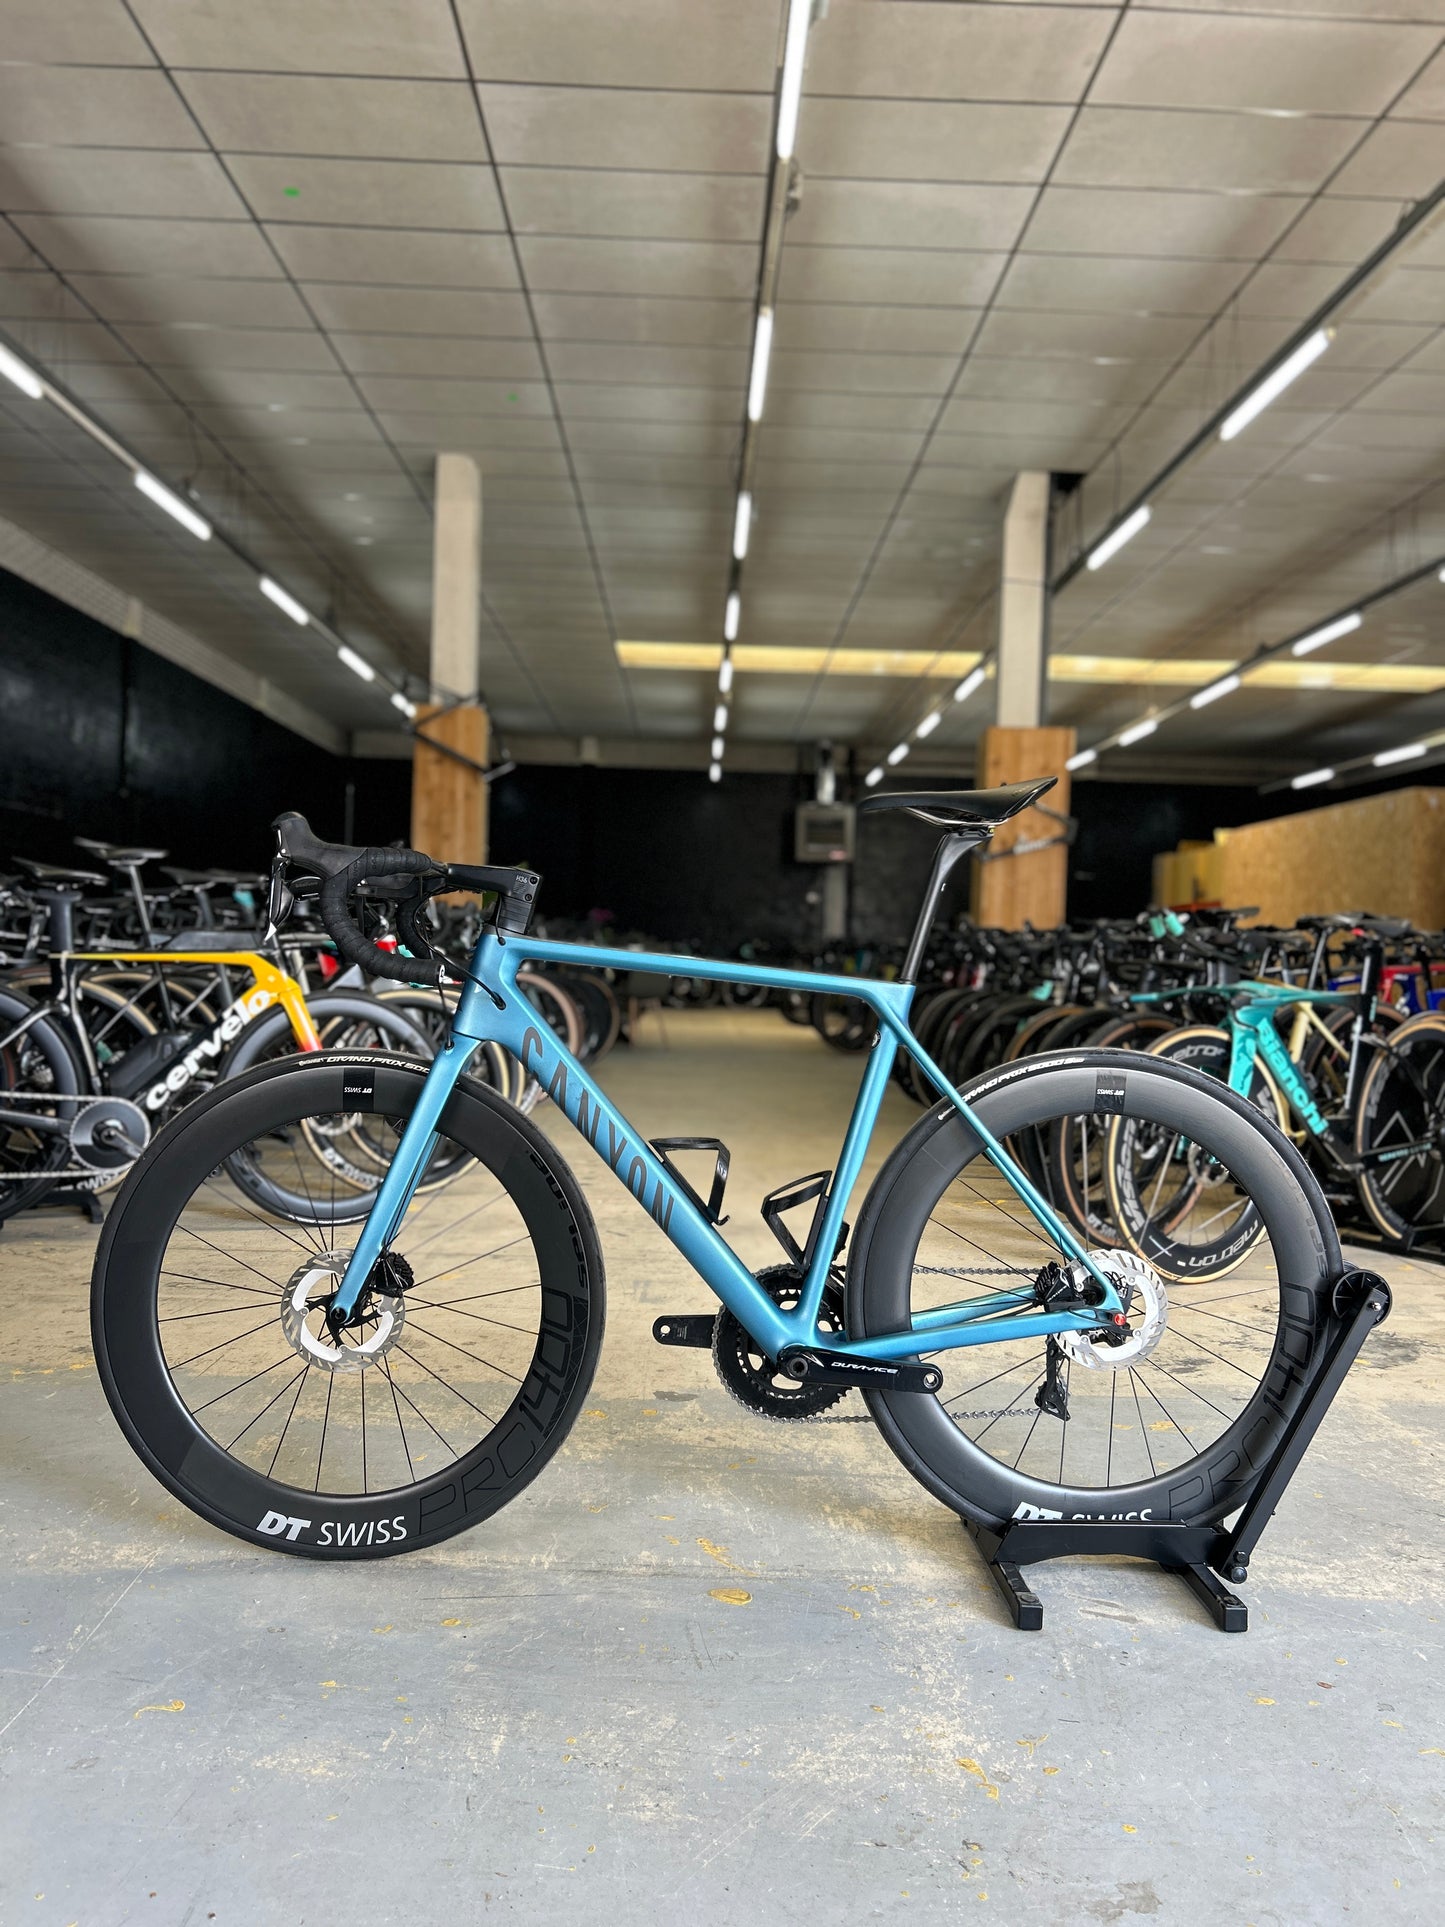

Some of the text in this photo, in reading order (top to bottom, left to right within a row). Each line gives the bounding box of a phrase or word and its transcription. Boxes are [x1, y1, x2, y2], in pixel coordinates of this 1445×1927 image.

[371, 1057, 406, 1067] PRIX
[1257, 1017, 1329, 1135] Bianchi
[521, 1026, 675, 1236] CANYON
[256, 1510, 312, 1541] DT
[316, 1515, 408, 1547] SWISS
